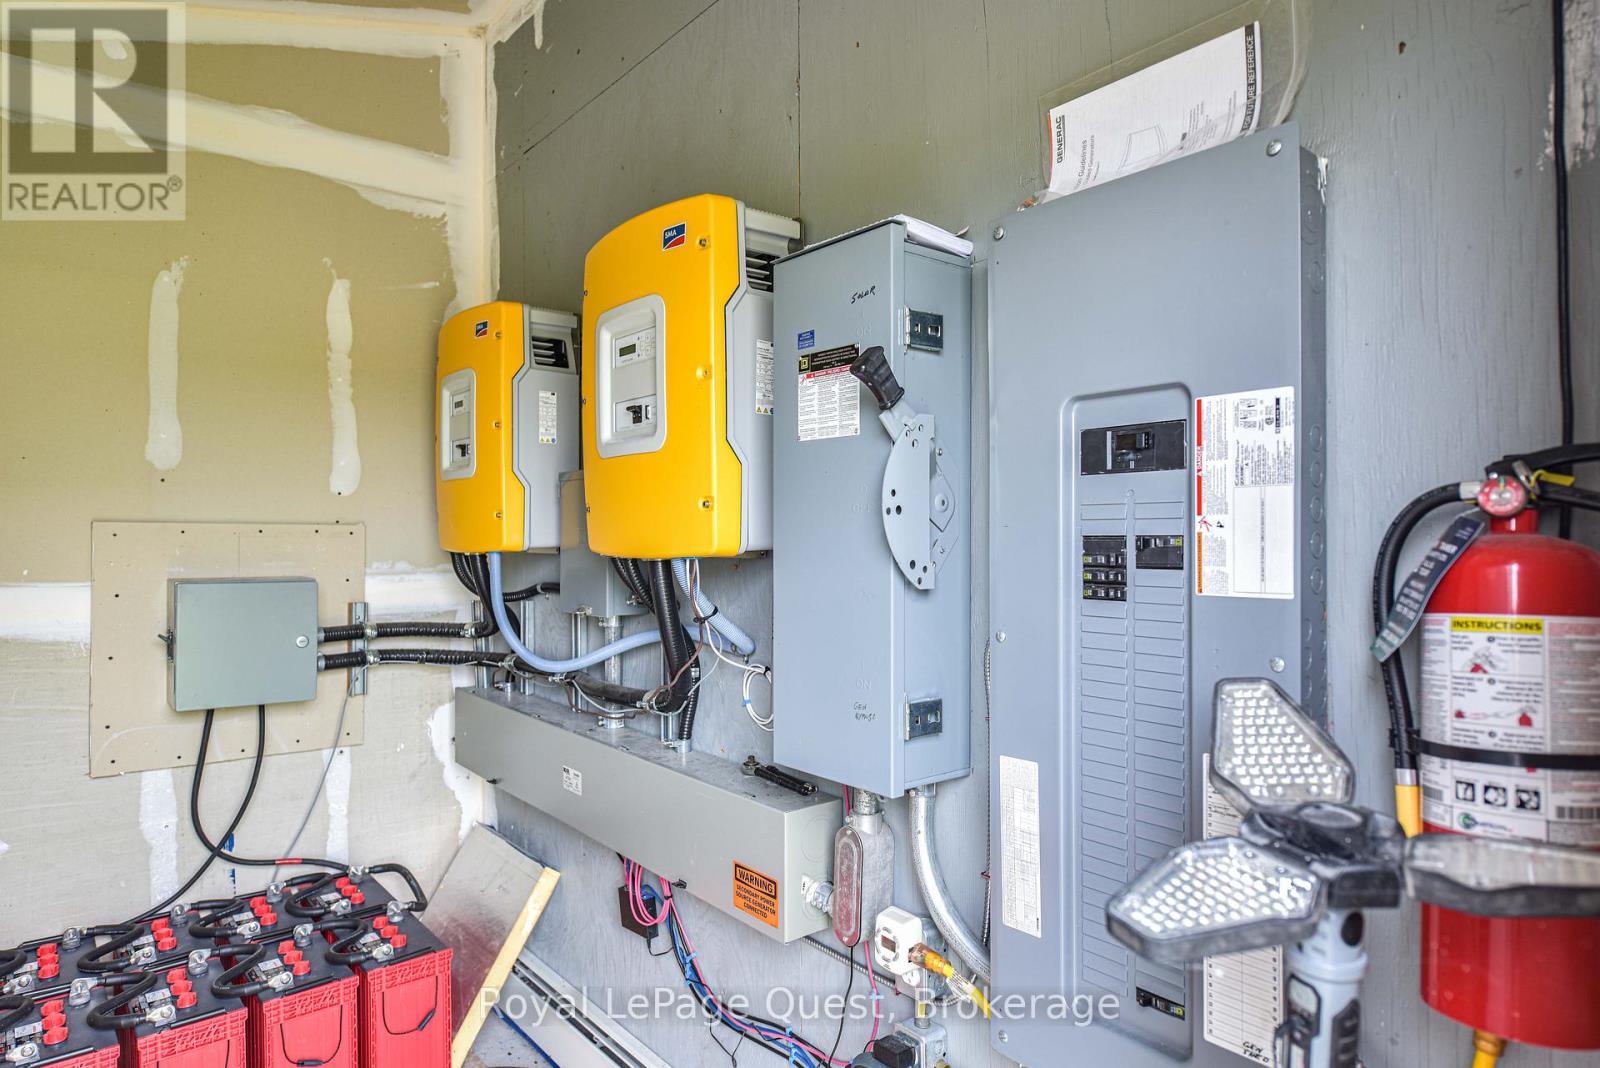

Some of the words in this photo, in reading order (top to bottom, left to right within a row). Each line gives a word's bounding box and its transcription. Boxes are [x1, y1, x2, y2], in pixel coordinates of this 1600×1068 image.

[1246, 35, 1256, 83] REFERENCE
[1247, 84, 1256, 114] FUTURE
[1453, 619, 1542, 631] INSTRUCTIONS
[738, 869, 773, 892] WARNING
[736, 884, 760, 899] SECONDARY
[760, 896, 775, 907] POWER
[736, 890, 752, 903] SOURCE
[752, 899, 776, 915] GENERATOR
[743, 902, 768, 919] CONNECTED
